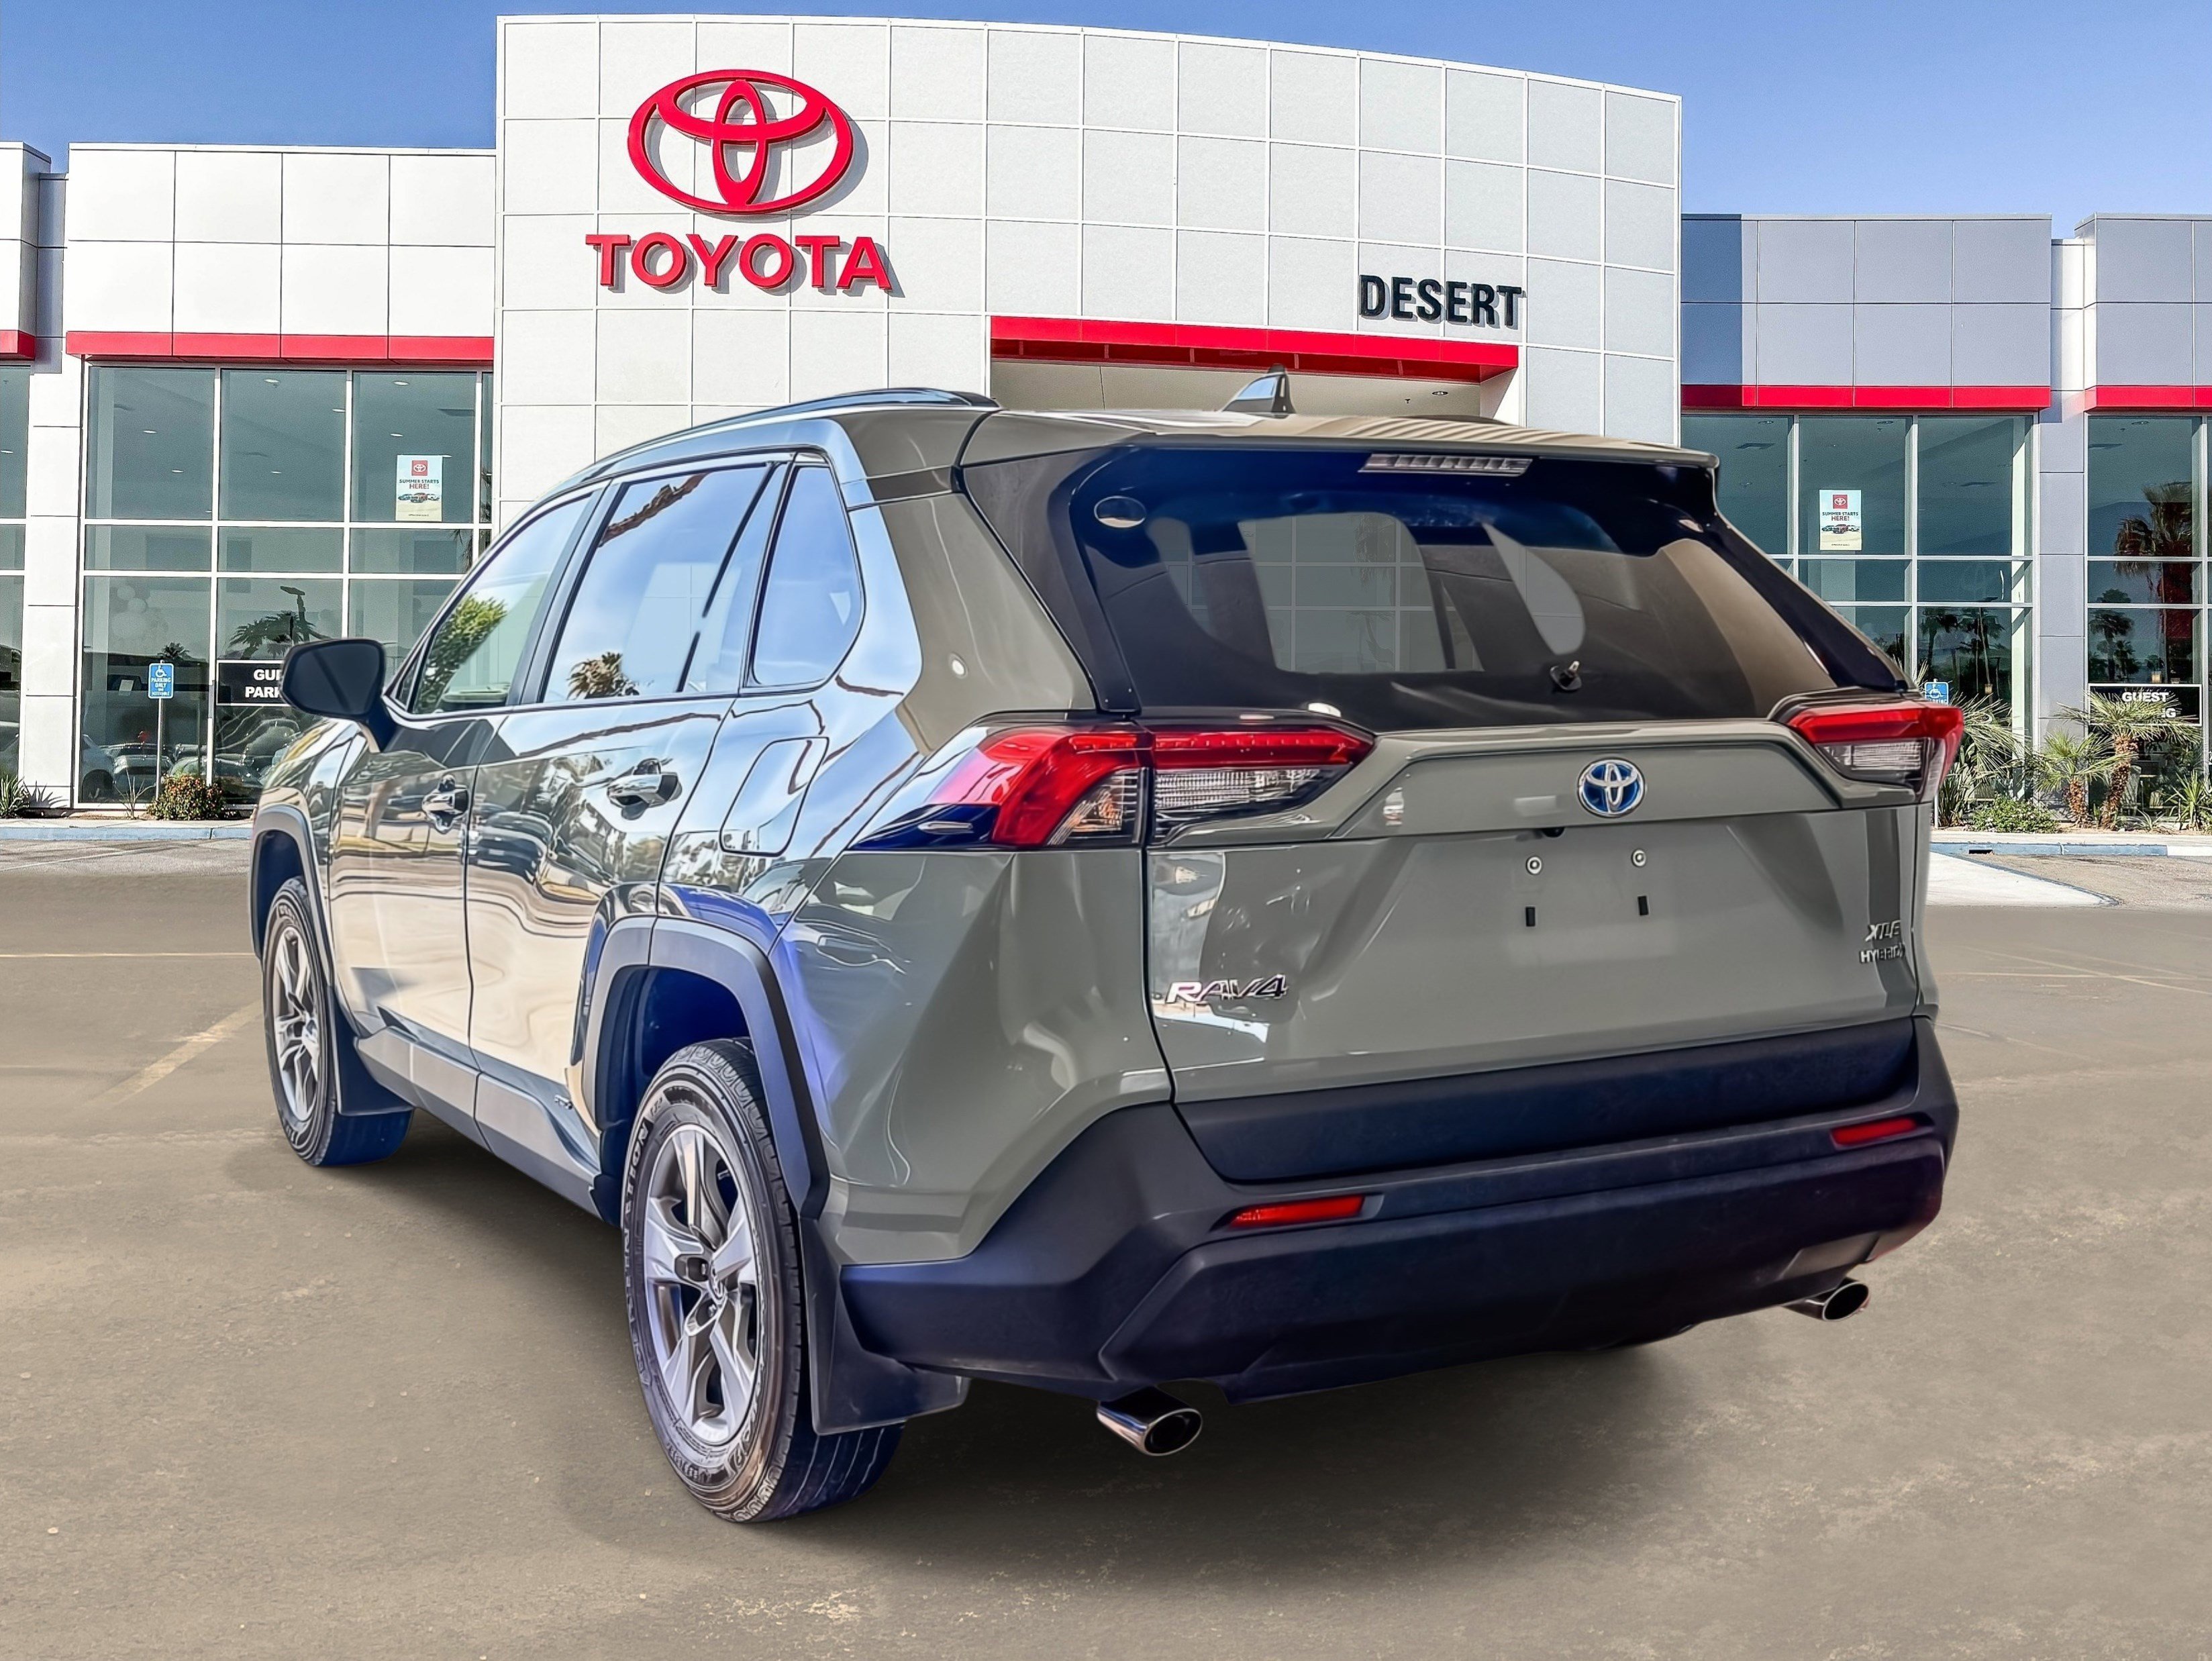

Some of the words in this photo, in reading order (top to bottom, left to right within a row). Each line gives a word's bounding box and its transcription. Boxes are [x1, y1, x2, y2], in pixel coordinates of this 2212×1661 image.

[585, 232, 893, 291] TOYOTA
[1358, 274, 1522, 326] DESERT
[2121, 691, 2169, 702] GUEST
[1865, 920, 1901, 941] XLE
[1860, 943, 1904, 962] HYBRID
[1164, 974, 1288, 1004] RAV4
